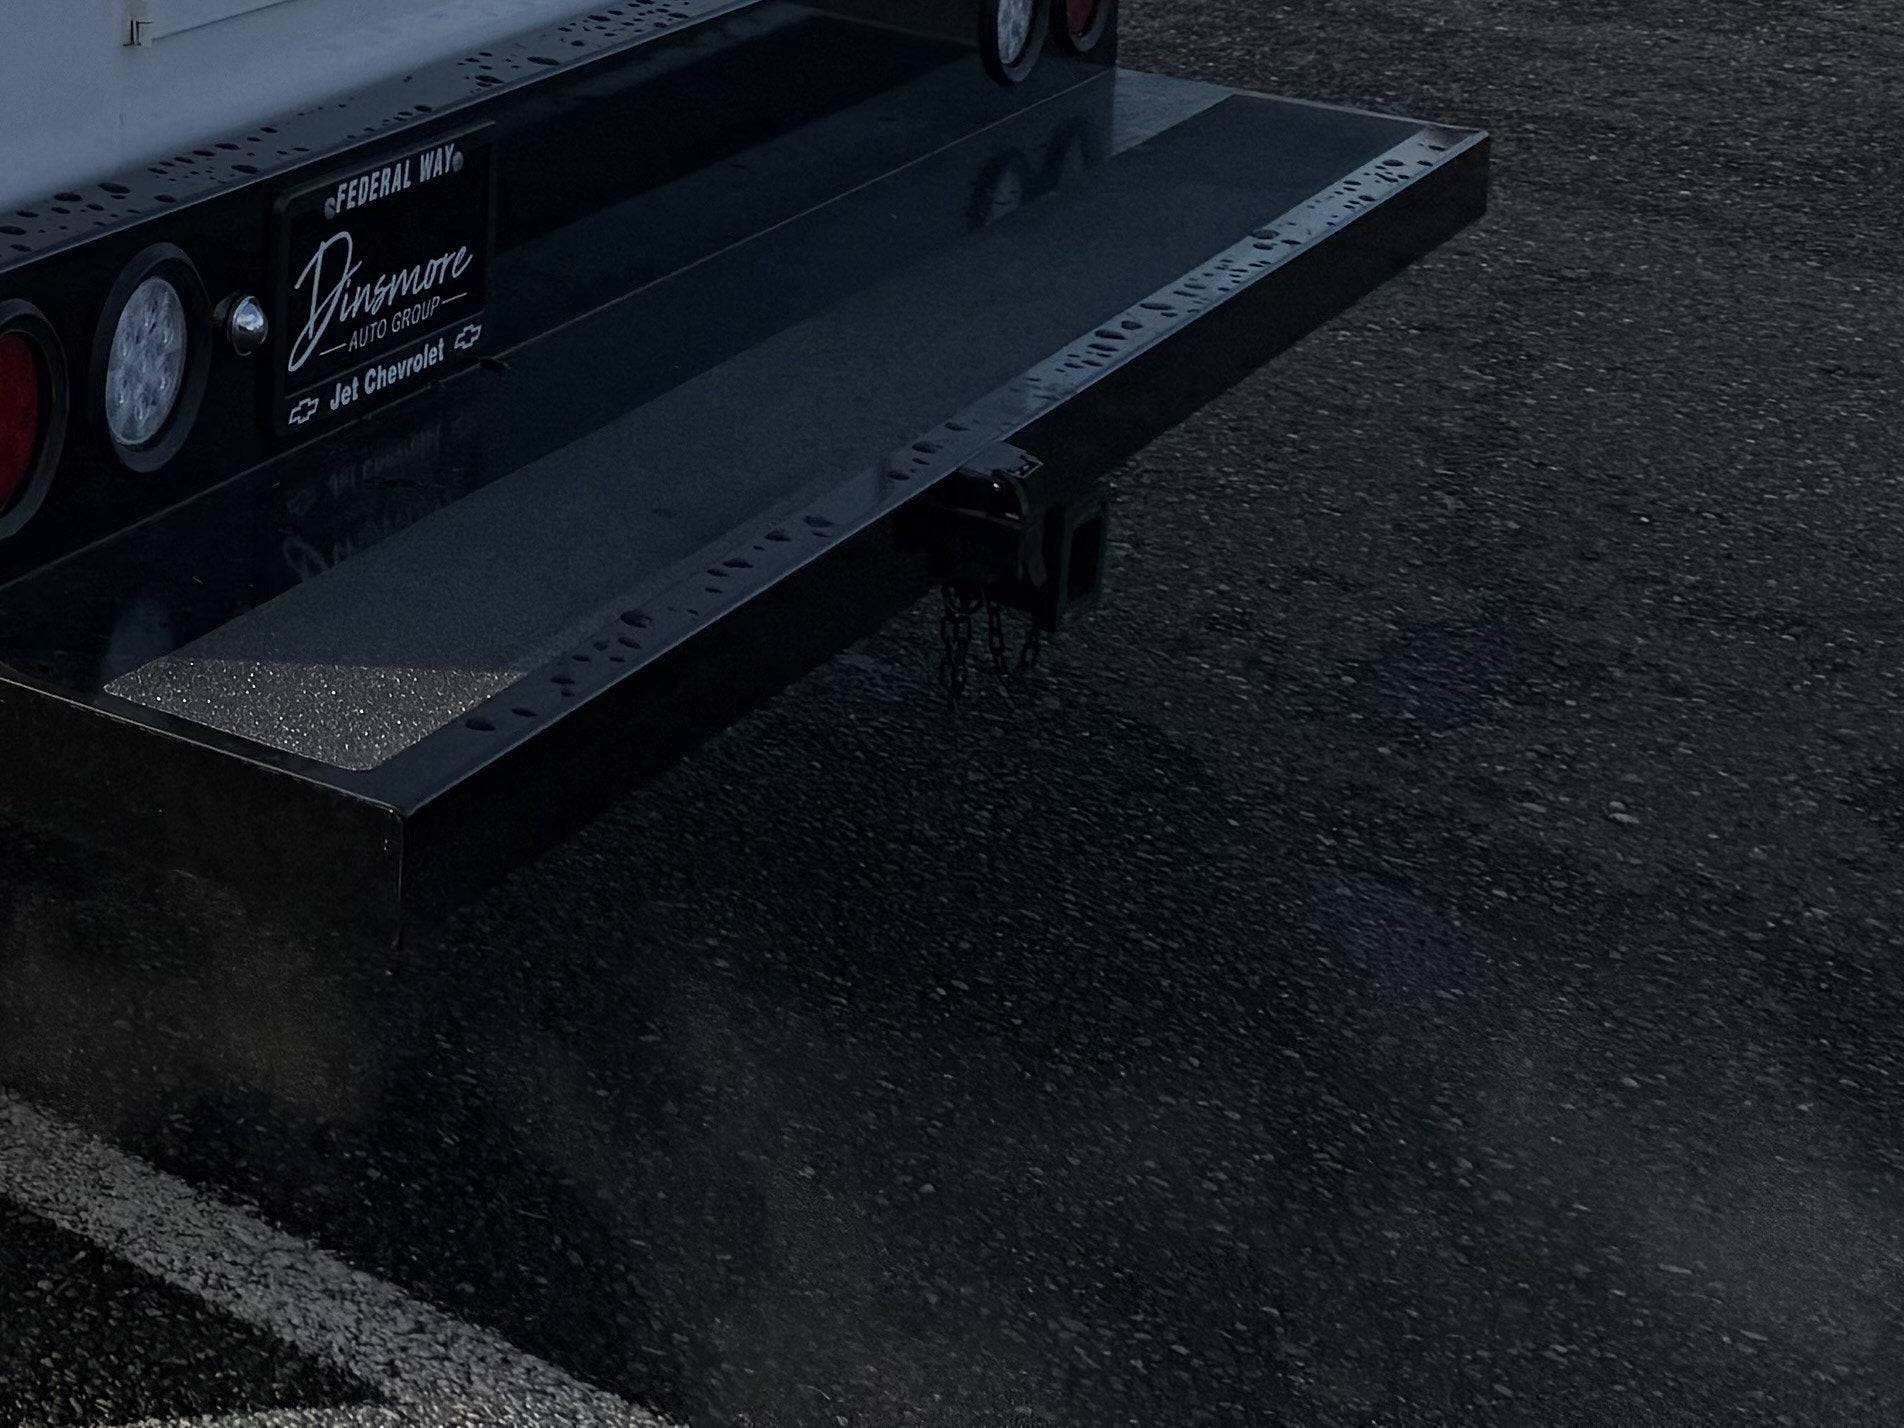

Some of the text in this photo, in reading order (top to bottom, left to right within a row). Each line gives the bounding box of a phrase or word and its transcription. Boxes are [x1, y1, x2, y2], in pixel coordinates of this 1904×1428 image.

[335, 143, 455, 214] FEDERAL WAY
[288, 230, 473, 372] Dinsmore
[348, 295, 441, 353] AUTO GROUP
[329, 337, 445, 411] Jet Chevrolet
